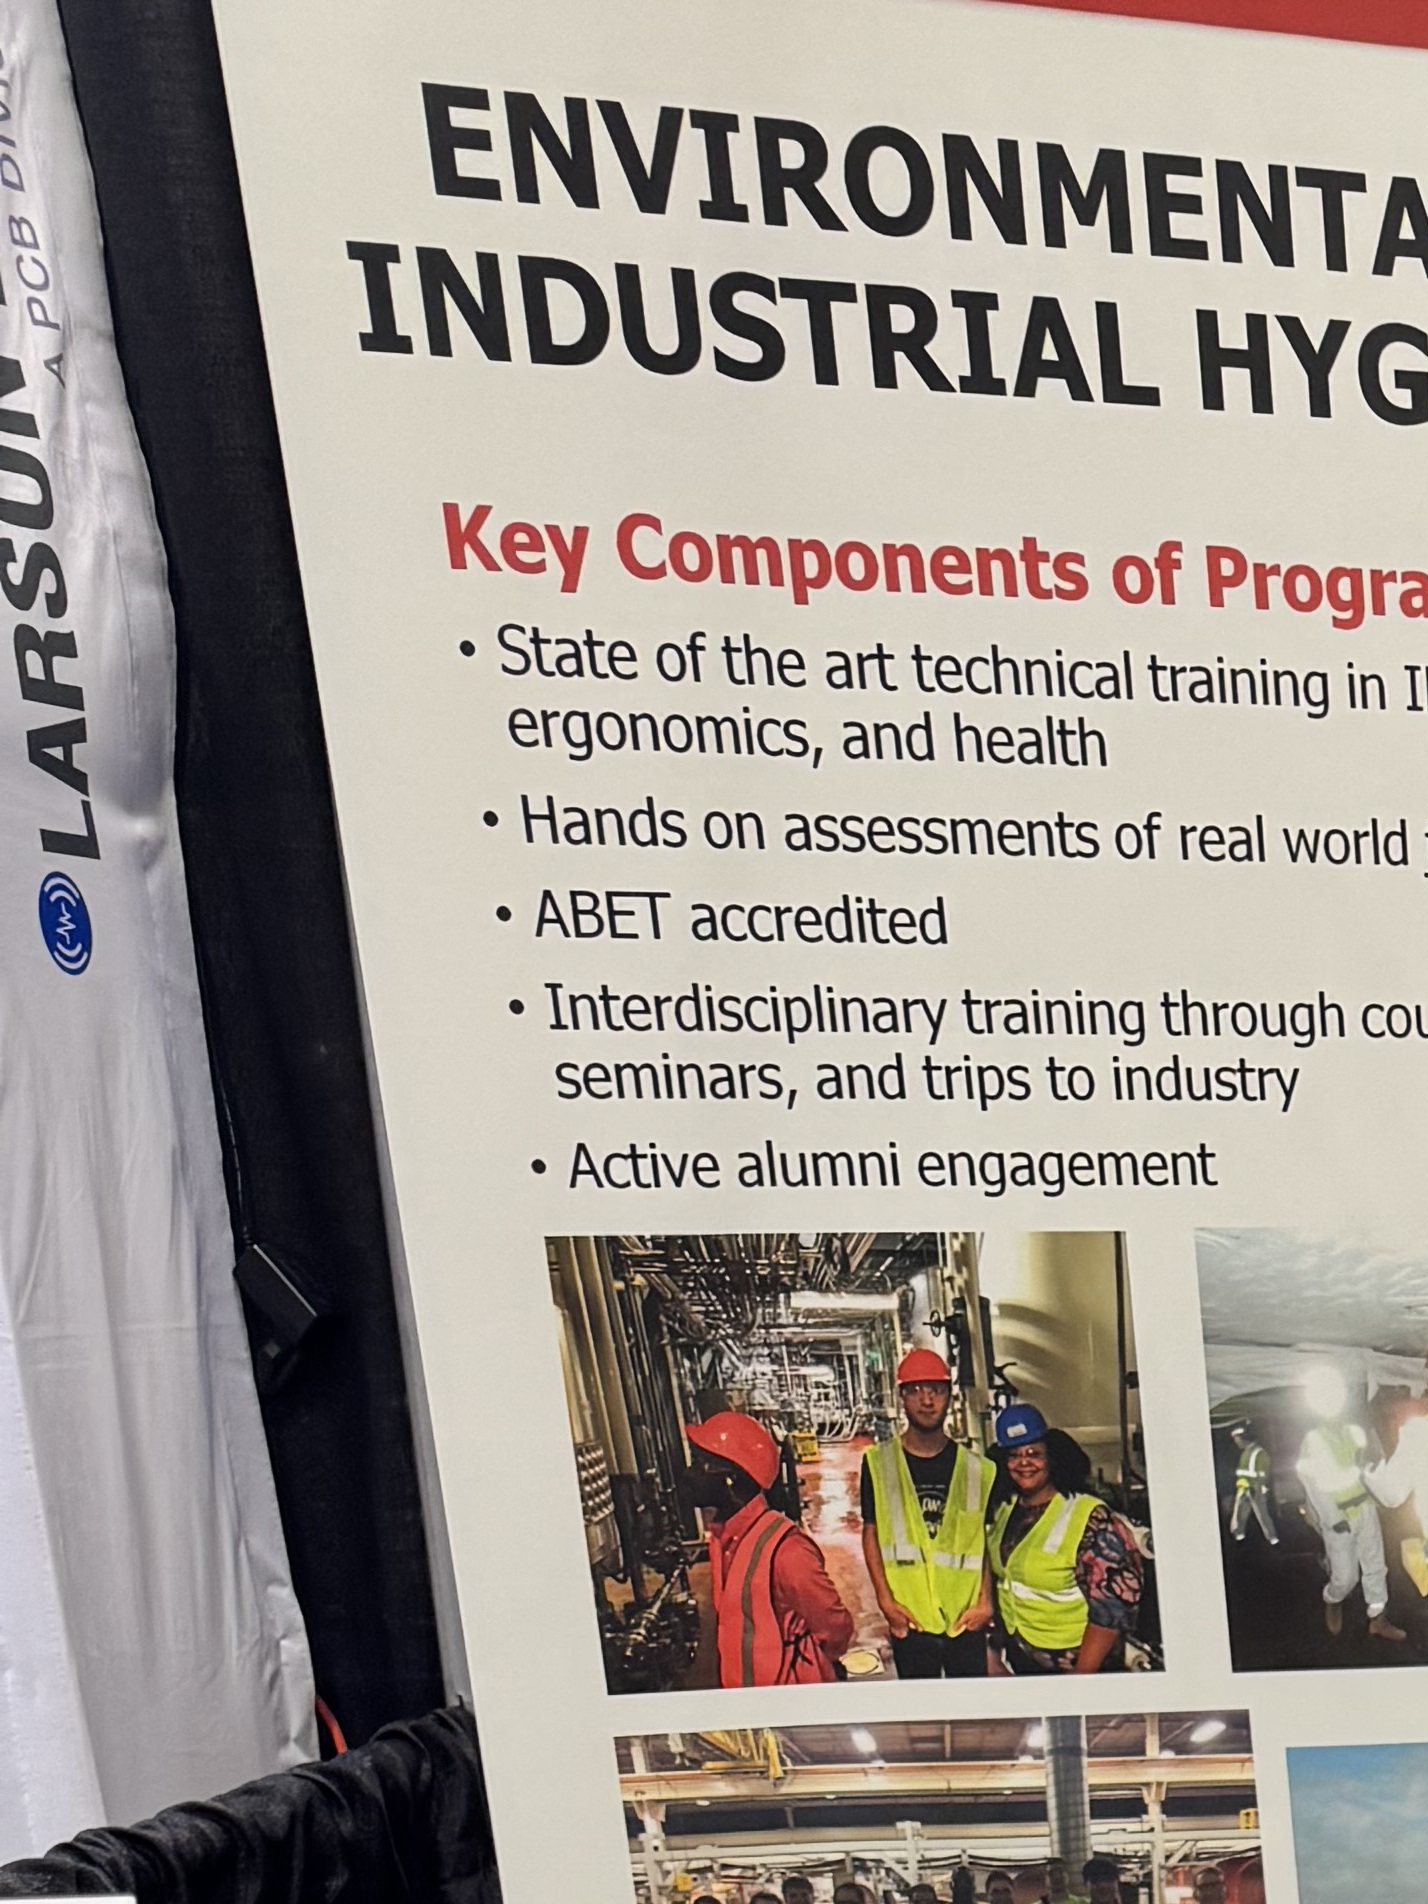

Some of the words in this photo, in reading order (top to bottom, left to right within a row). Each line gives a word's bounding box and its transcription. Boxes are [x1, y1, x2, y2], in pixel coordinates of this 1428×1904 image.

[10, 213, 62, 331] PCB
[346, 241, 1161, 406] INDUSTRIAL
[44, 353, 66, 387] A
[443, 502, 589, 593] Key
[616, 513, 1089, 605] Components
[1112, 541, 1183, 605] of
[498, 623, 638, 680] State
[657, 631, 706, 682] of
[721, 633, 806, 687] the
[826, 643, 898, 691] art
[911, 644, 1133, 700] technical
[1147, 655, 1329, 719] training
[1347, 662, 1386, 710] in
[509, 706, 823, 769] ergonomics,
[843, 711, 935, 761] and
[953, 712, 1107, 766] health
[521, 795, 687, 848] Hands
[704, 811, 765, 849] on
[785, 812, 1100, 858] assessments
[1115, 812, 1162, 859] of
[1180, 815, 1265, 862] real
[1283, 818, 1408, 866] world
[536, 890, 671, 939] ABET
[691, 894, 947, 945] accredited
[544, 983, 947, 1045] Interdisciplinary
[961, 989, 1145, 1046] training
[1160, 989, 1345, 1048] through
[556, 1053, 797, 1110] seminars,
[817, 1052, 906, 1100] and
[922, 1055, 1031, 1111] trips
[1046, 1057, 1095, 1100] to
[1113, 1054, 1299, 1112] industry
[570, 1143, 720, 1189] Active
[738, 1140, 900, 1187] alumni
[918, 1143, 1218, 1197] engagement
